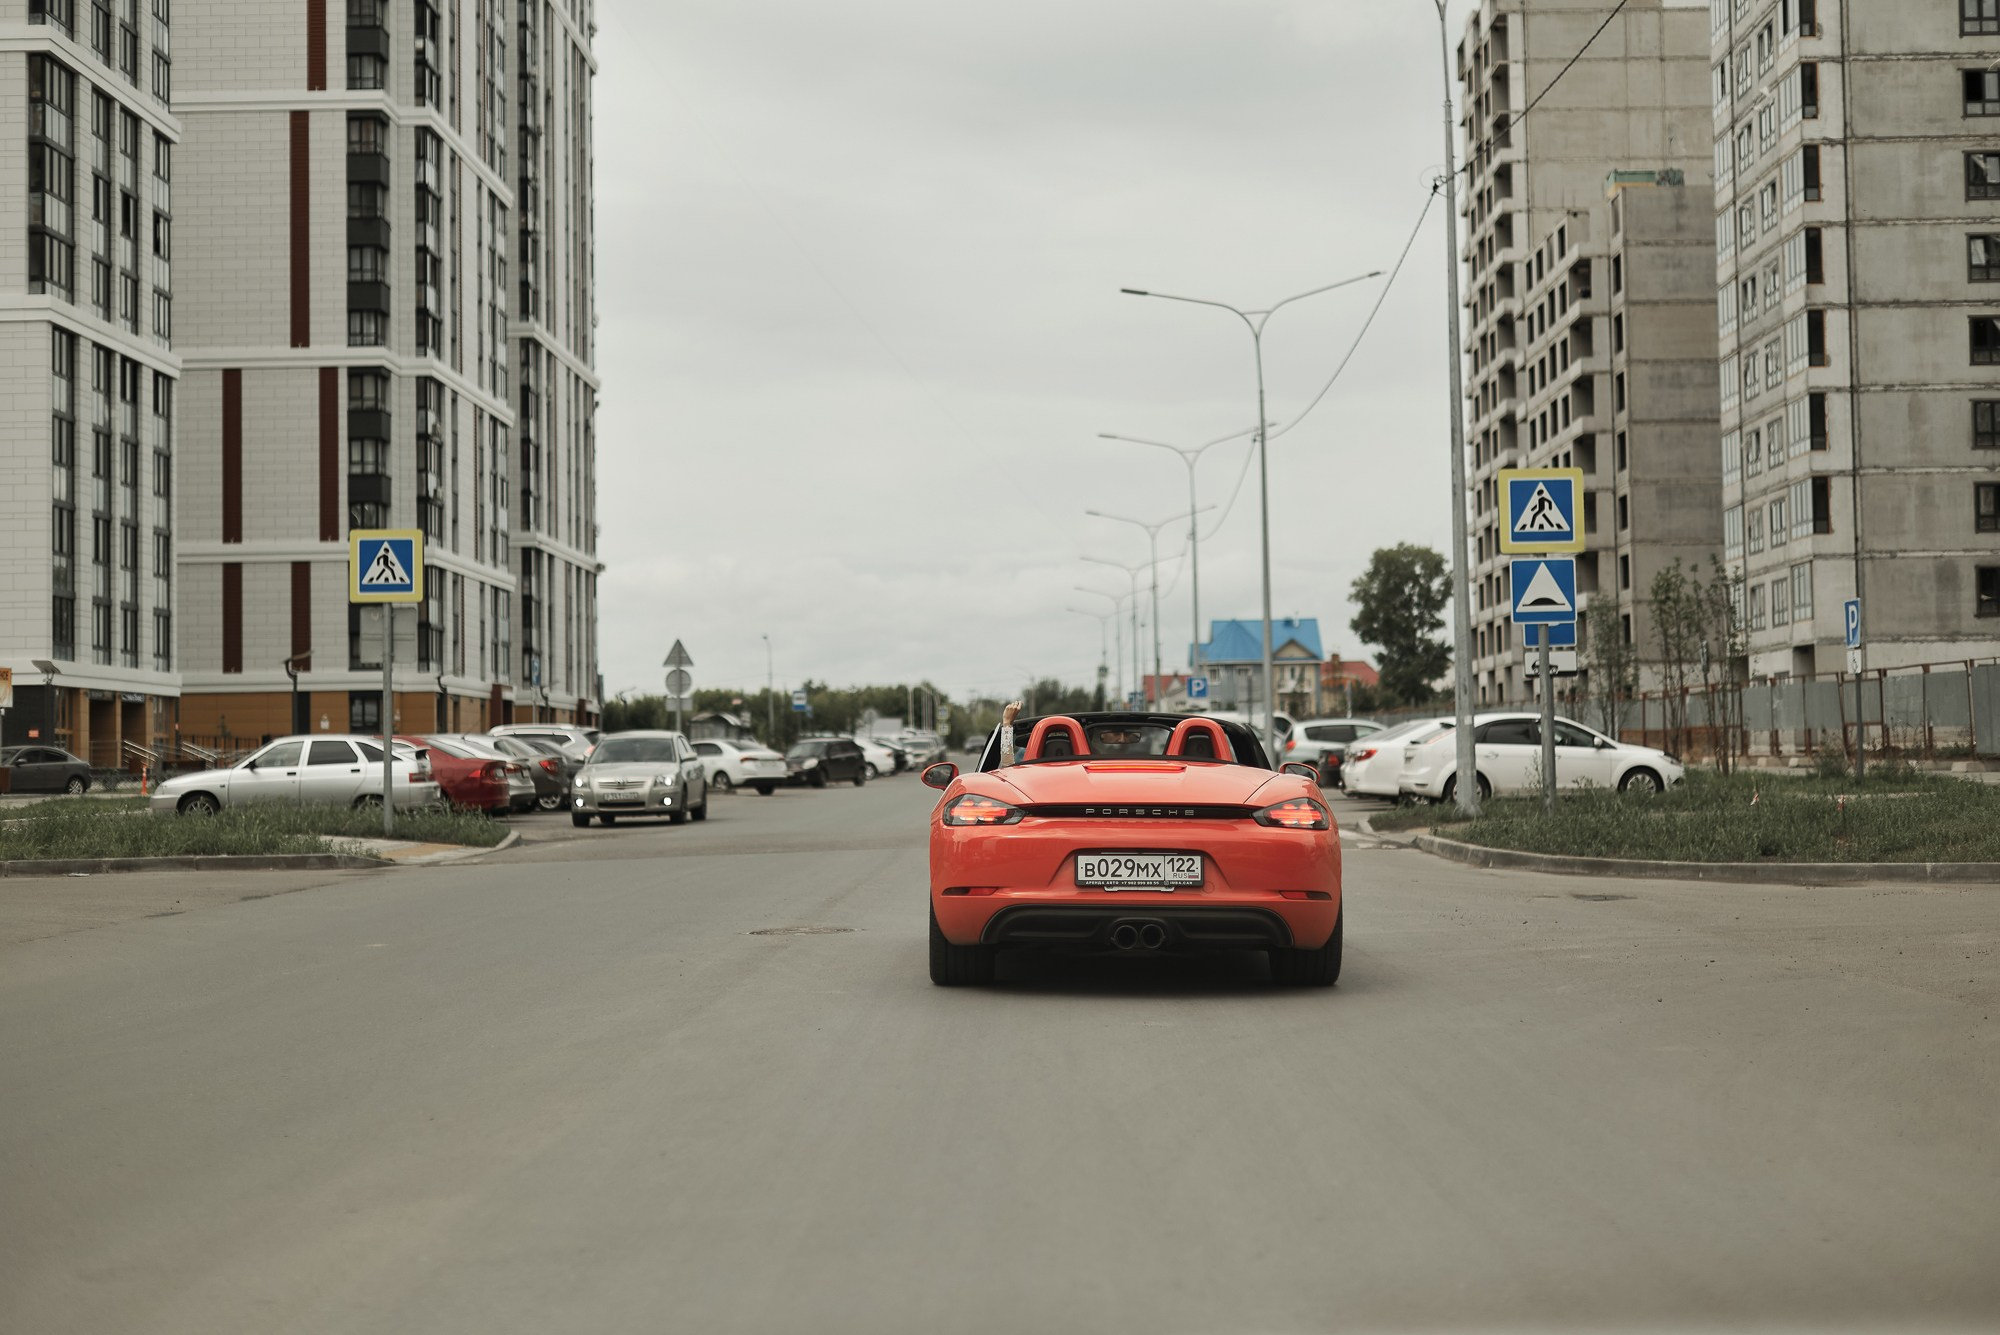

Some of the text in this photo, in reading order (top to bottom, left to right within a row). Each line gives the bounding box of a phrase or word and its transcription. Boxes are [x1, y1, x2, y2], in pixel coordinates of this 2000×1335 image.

[1848, 605, 1858, 641] P
[1191, 679, 1205, 697] P
[1084, 857, 1196, 878] В029МХ 122
